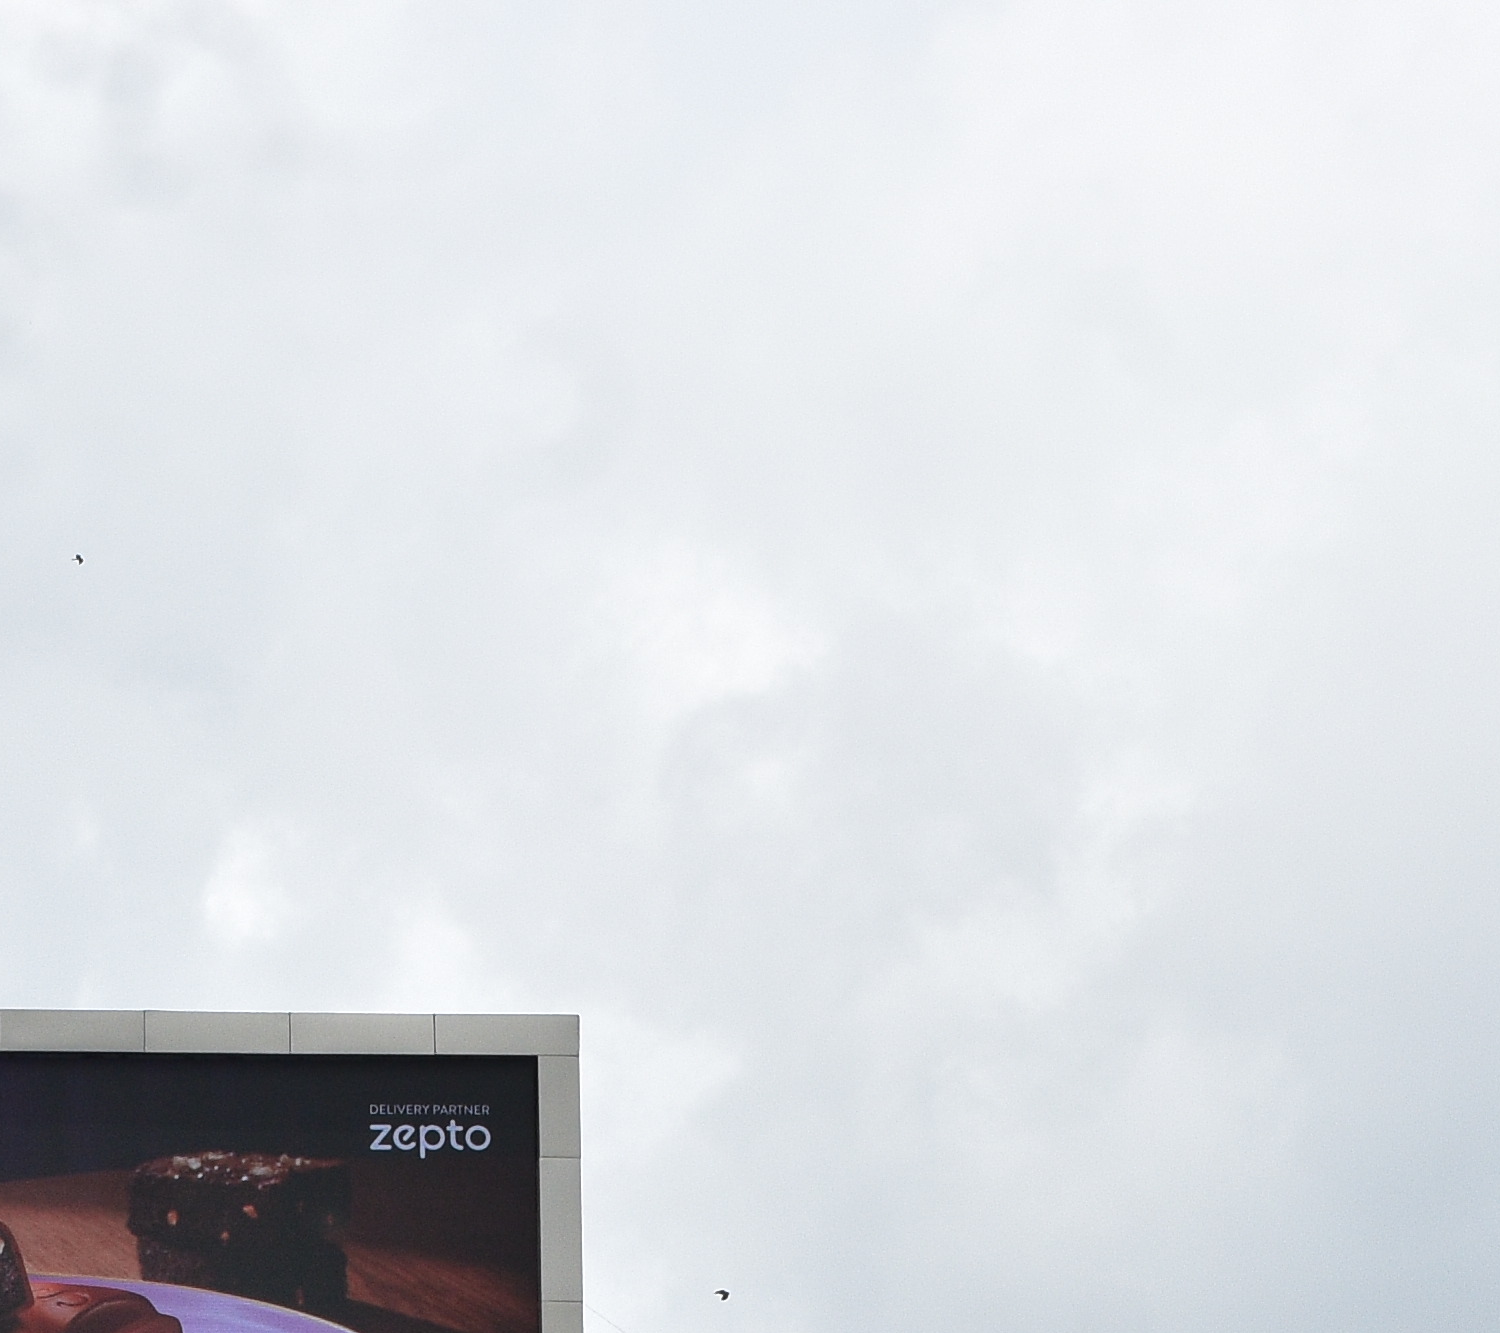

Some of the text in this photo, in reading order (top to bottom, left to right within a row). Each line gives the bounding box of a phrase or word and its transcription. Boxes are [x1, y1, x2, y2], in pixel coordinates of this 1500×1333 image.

[369, 1104, 490, 1115] DELIVERY PARTNER
[369, 1119, 492, 1159] zepto
